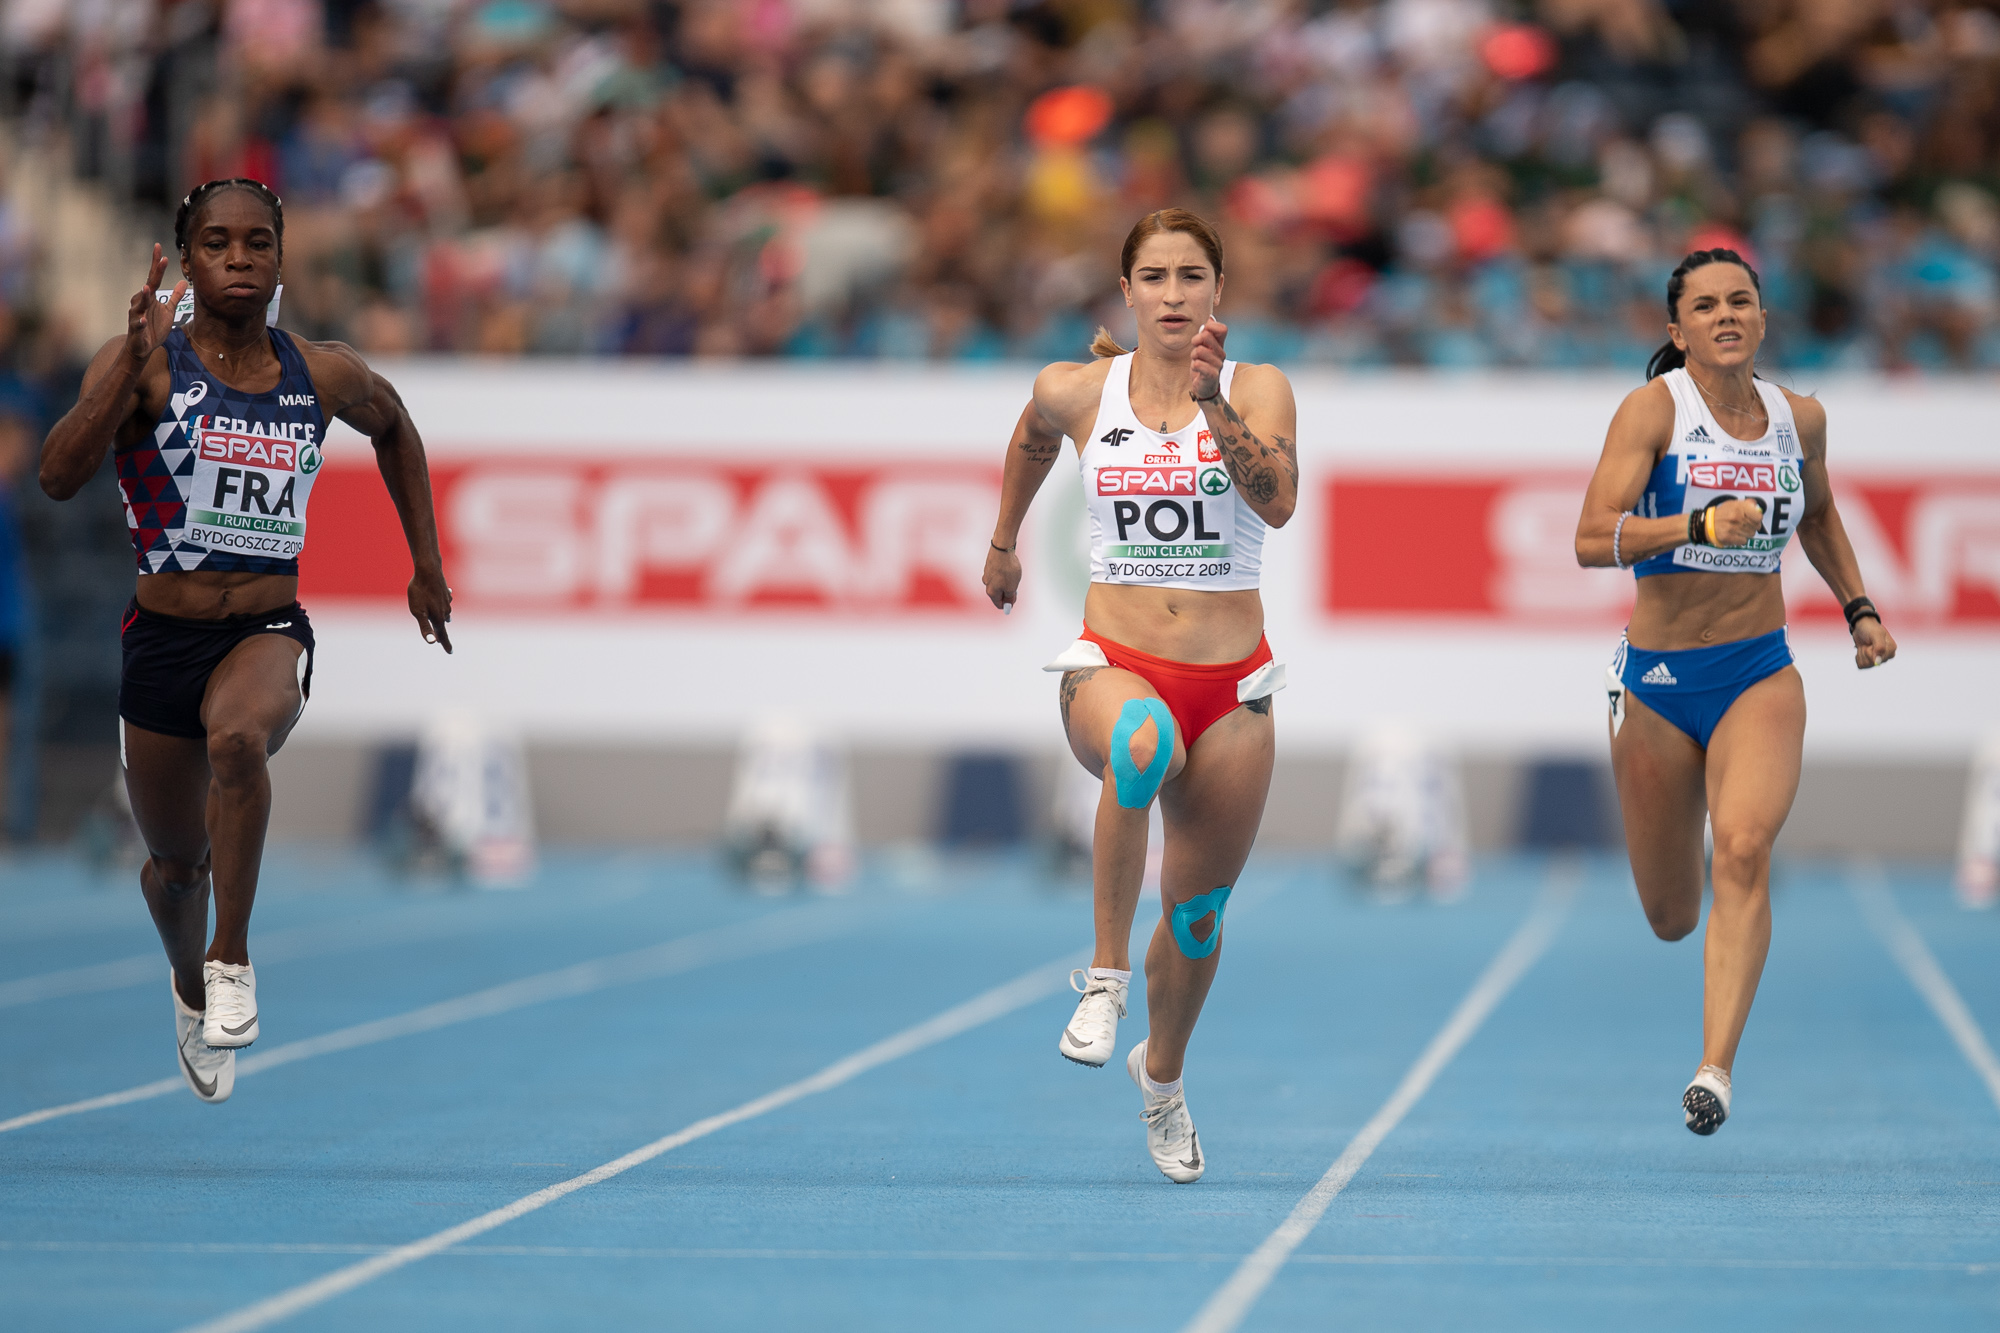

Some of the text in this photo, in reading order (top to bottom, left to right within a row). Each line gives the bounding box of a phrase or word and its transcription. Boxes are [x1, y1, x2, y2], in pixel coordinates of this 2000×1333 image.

[279, 394, 315, 407] MAIF
[1100, 428, 1135, 446] 4F
[1685, 435, 1716, 444] adidas
[203, 435, 294, 467] SPAR
[1146, 455, 1179, 463] ORLEN
[1738, 449, 1771, 457] AEGEAN
[1100, 470, 1194, 491] SPAR
[1692, 464, 1774, 488] SPAR
[212, 467, 296, 518] FRA
[216, 514, 221, 524] I
[224, 516, 251, 528] RUN
[1114, 499, 1220, 542] POL
[191, 528, 303, 554] BYDGOSZCZ 2019
[447, 470, 1005, 605] SPAR
[1127, 547, 1132, 556] I
[1134, 546, 1157, 556] RUN
[1683, 548, 1767, 567] BYDGOSZCZ
[1109, 563, 1231, 577] BYDGOSZCZ 2019
[1641, 675, 1677, 685] adidas
